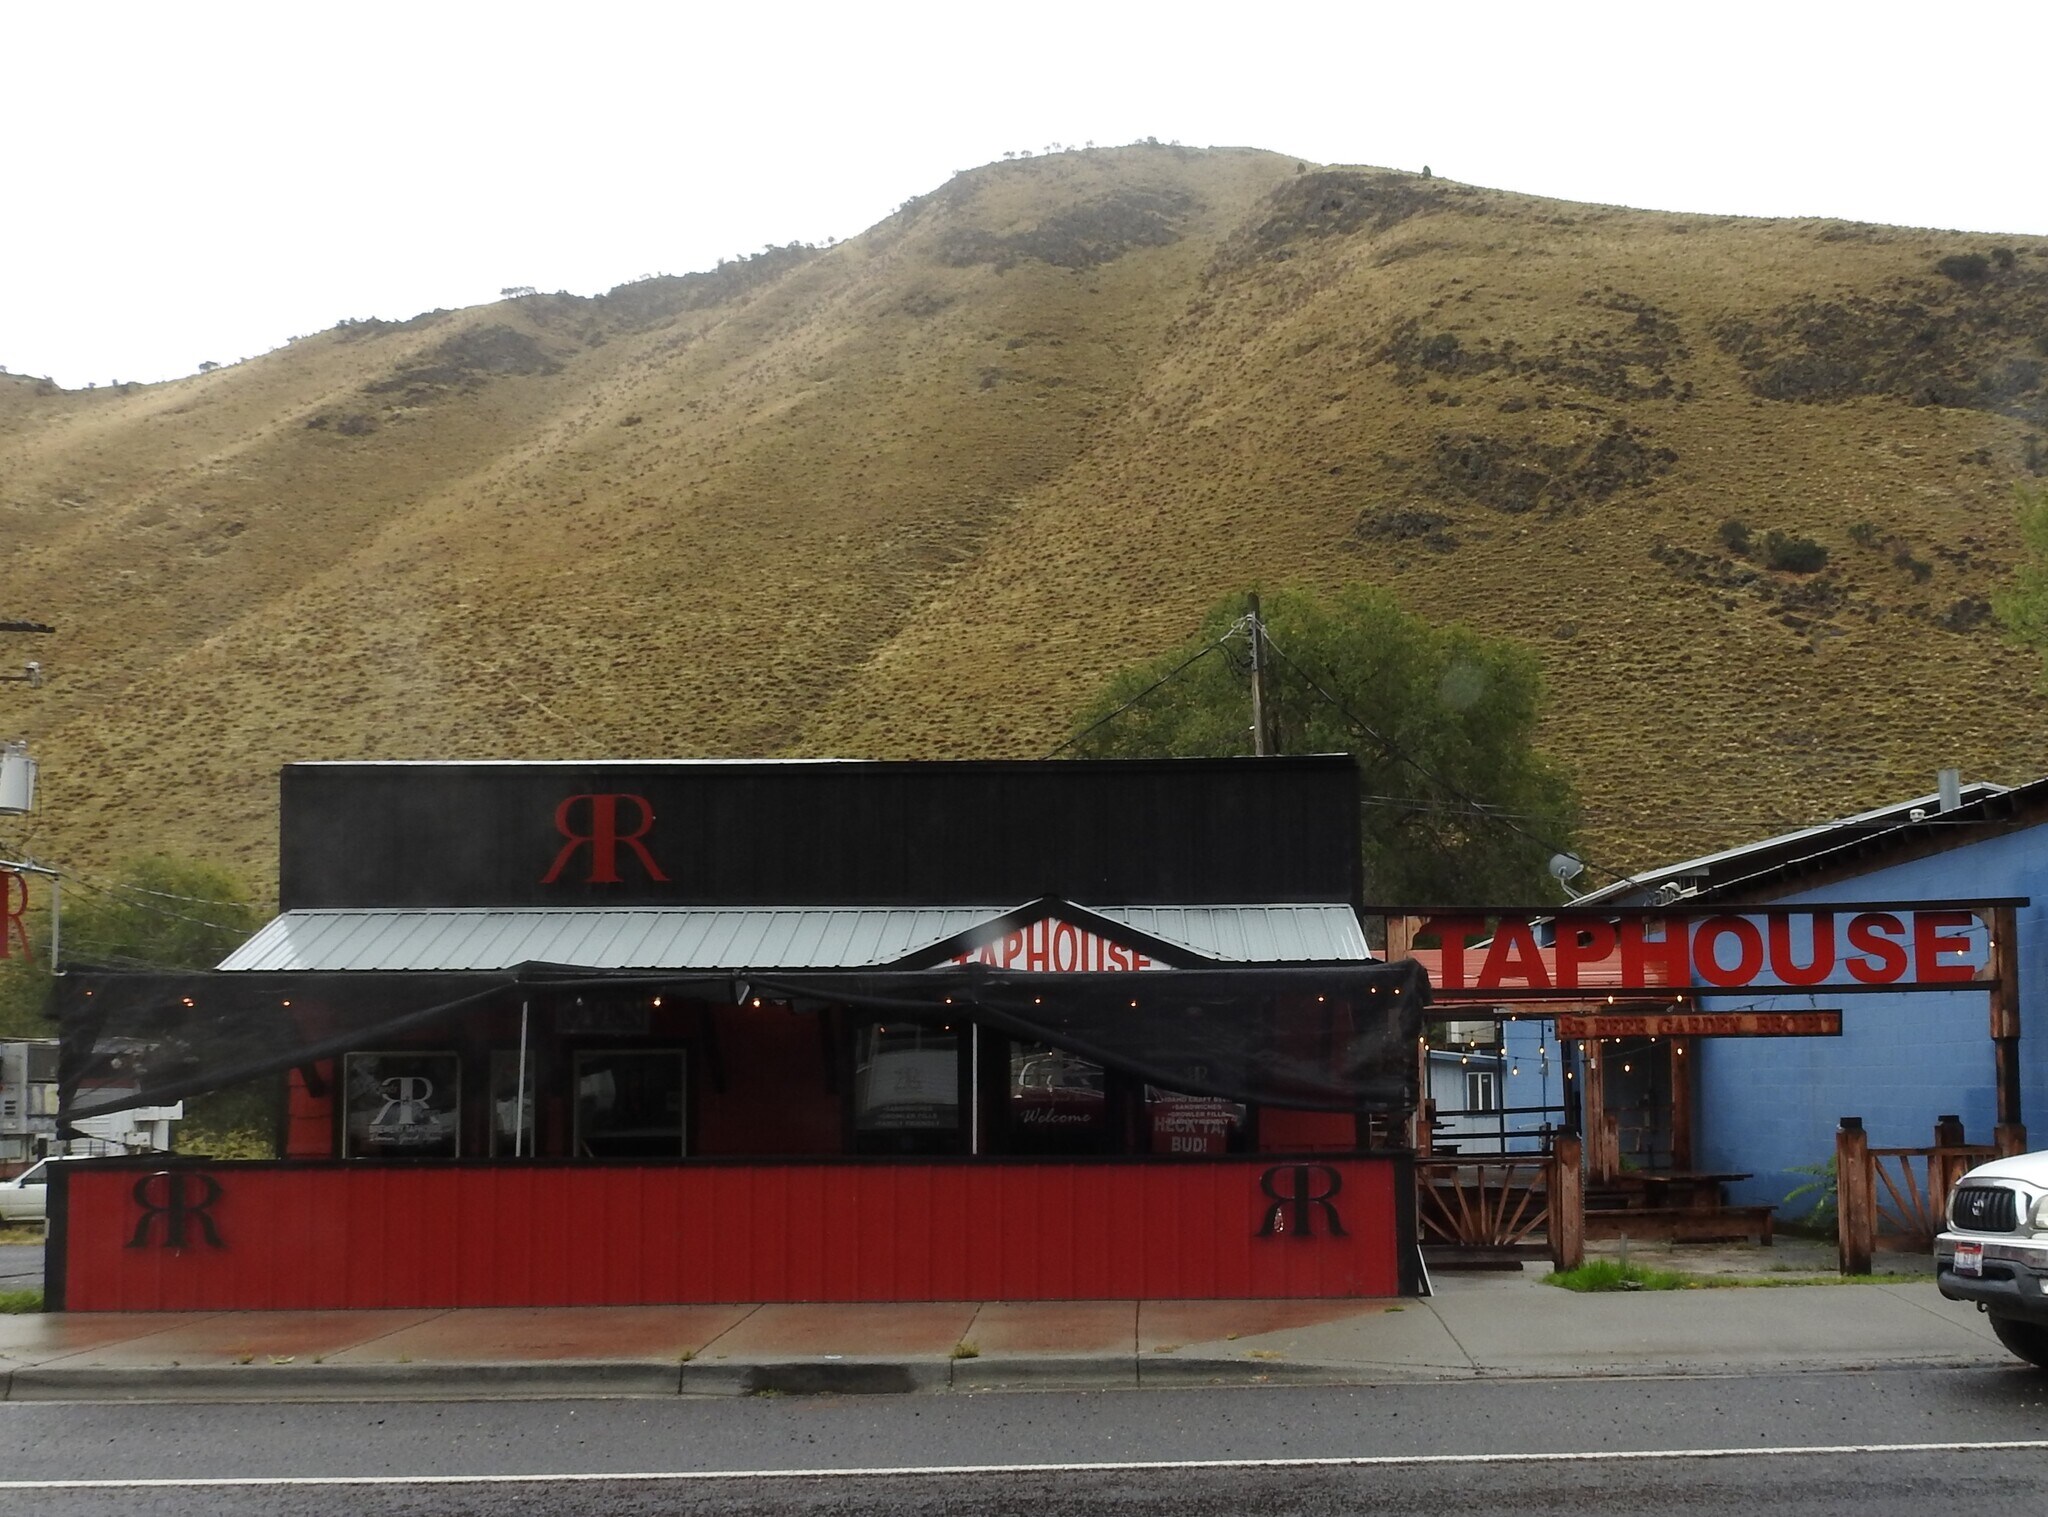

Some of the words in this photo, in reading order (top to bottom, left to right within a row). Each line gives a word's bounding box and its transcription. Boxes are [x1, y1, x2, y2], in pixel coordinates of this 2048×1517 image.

[1414, 911, 1975, 989] TAPHOUSE
[1657, 1014, 1742, 1035] GARDEN
[1020, 1107, 1092, 1123] Welcome
[1171, 1136, 1208, 1153] BUD!
